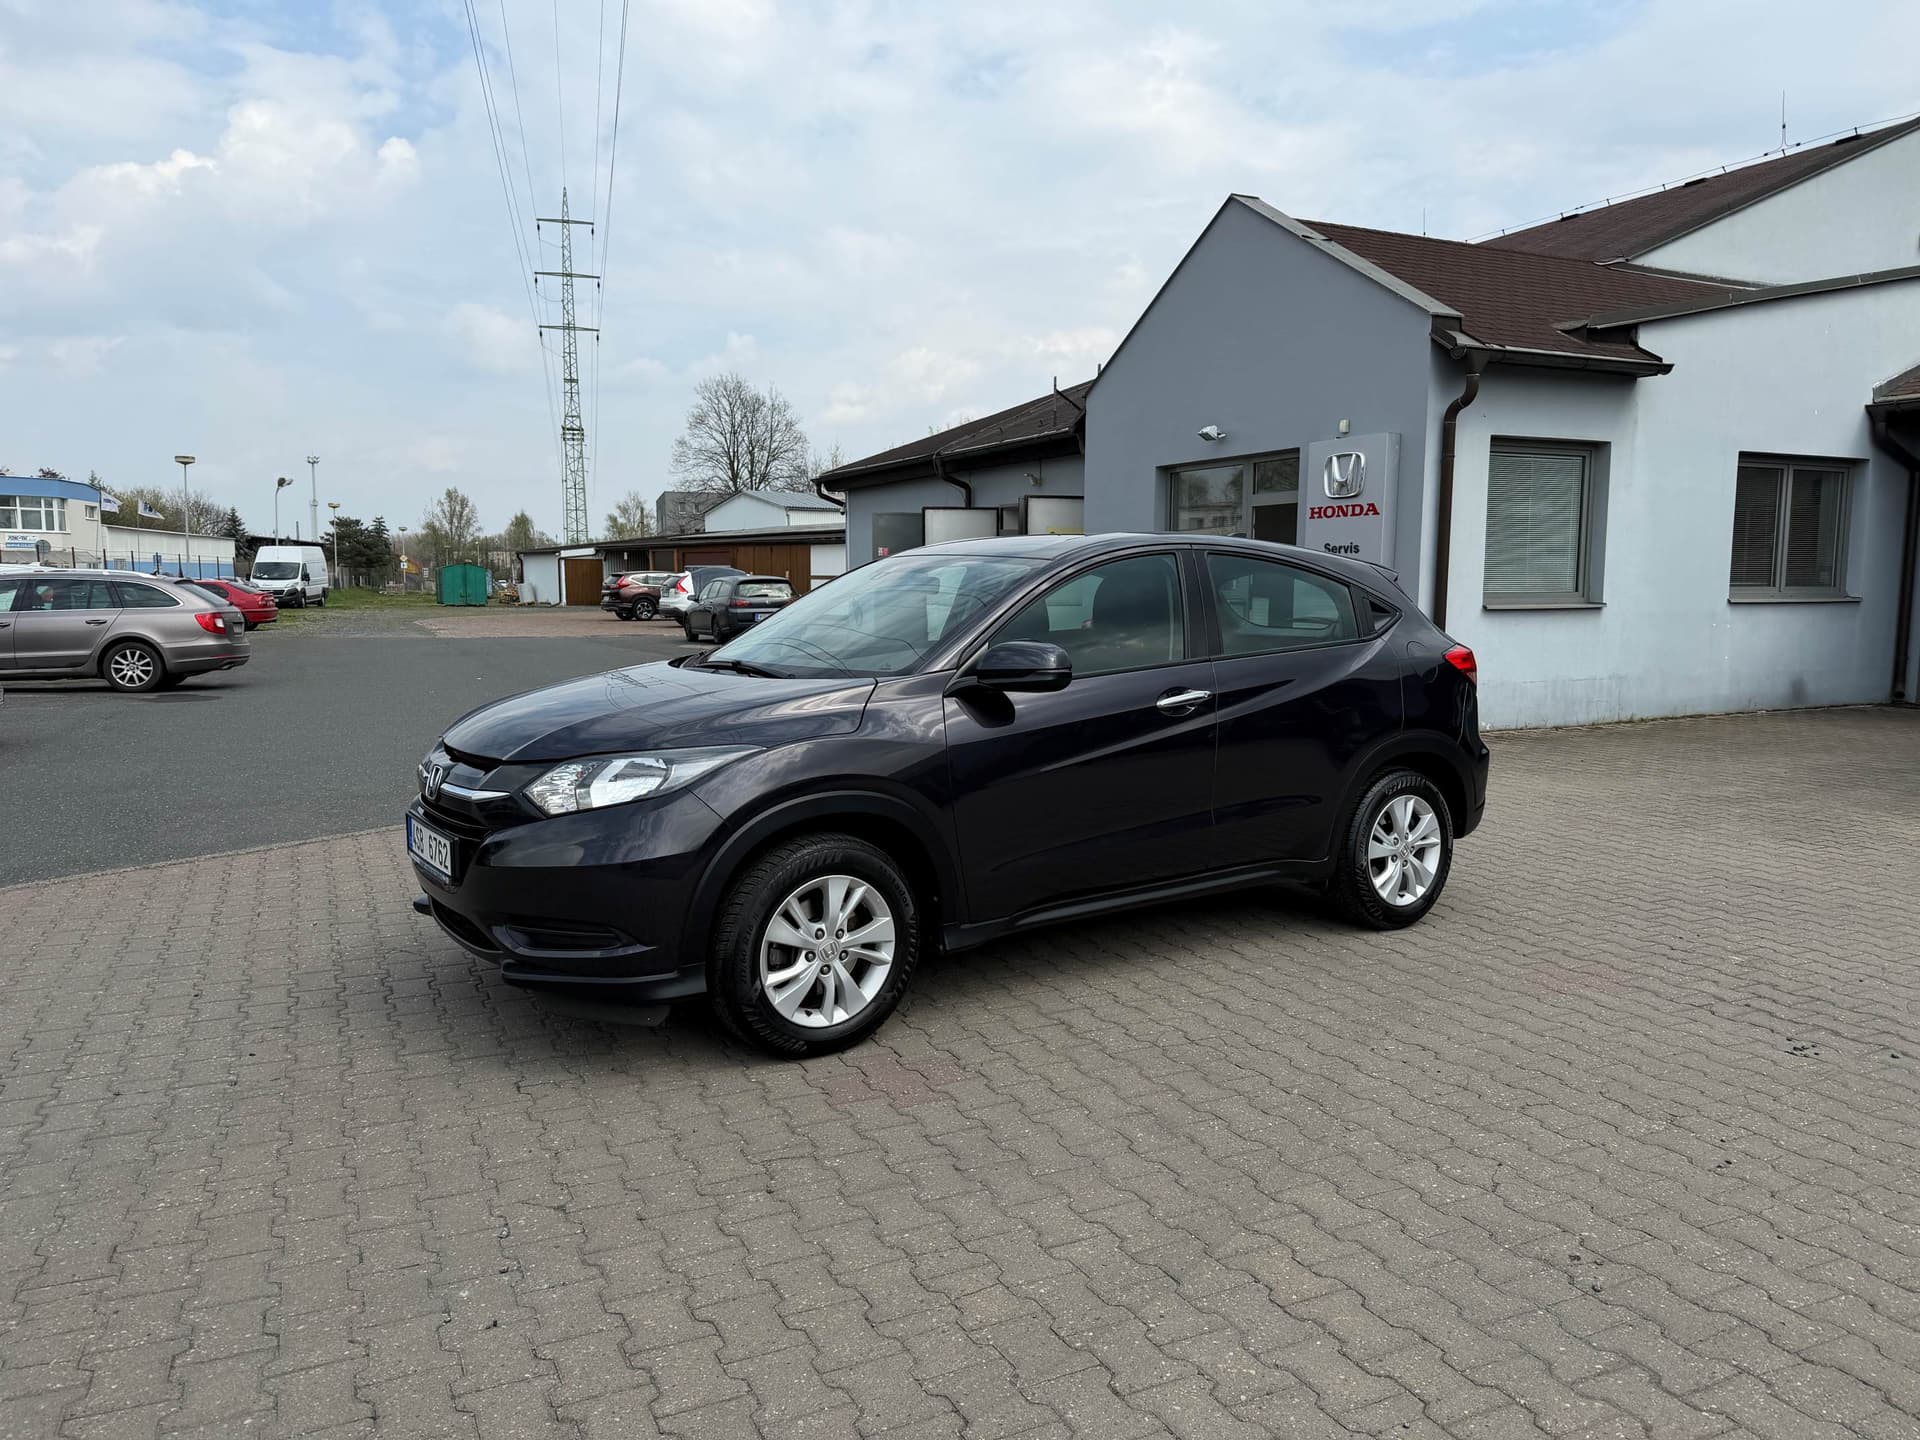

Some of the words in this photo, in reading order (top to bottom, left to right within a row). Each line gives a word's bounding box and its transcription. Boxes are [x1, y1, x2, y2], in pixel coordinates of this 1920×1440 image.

[1309, 502, 1380, 520] HONDA
[1323, 542, 1360, 554] Servis
[428, 833, 449, 871] 6762
